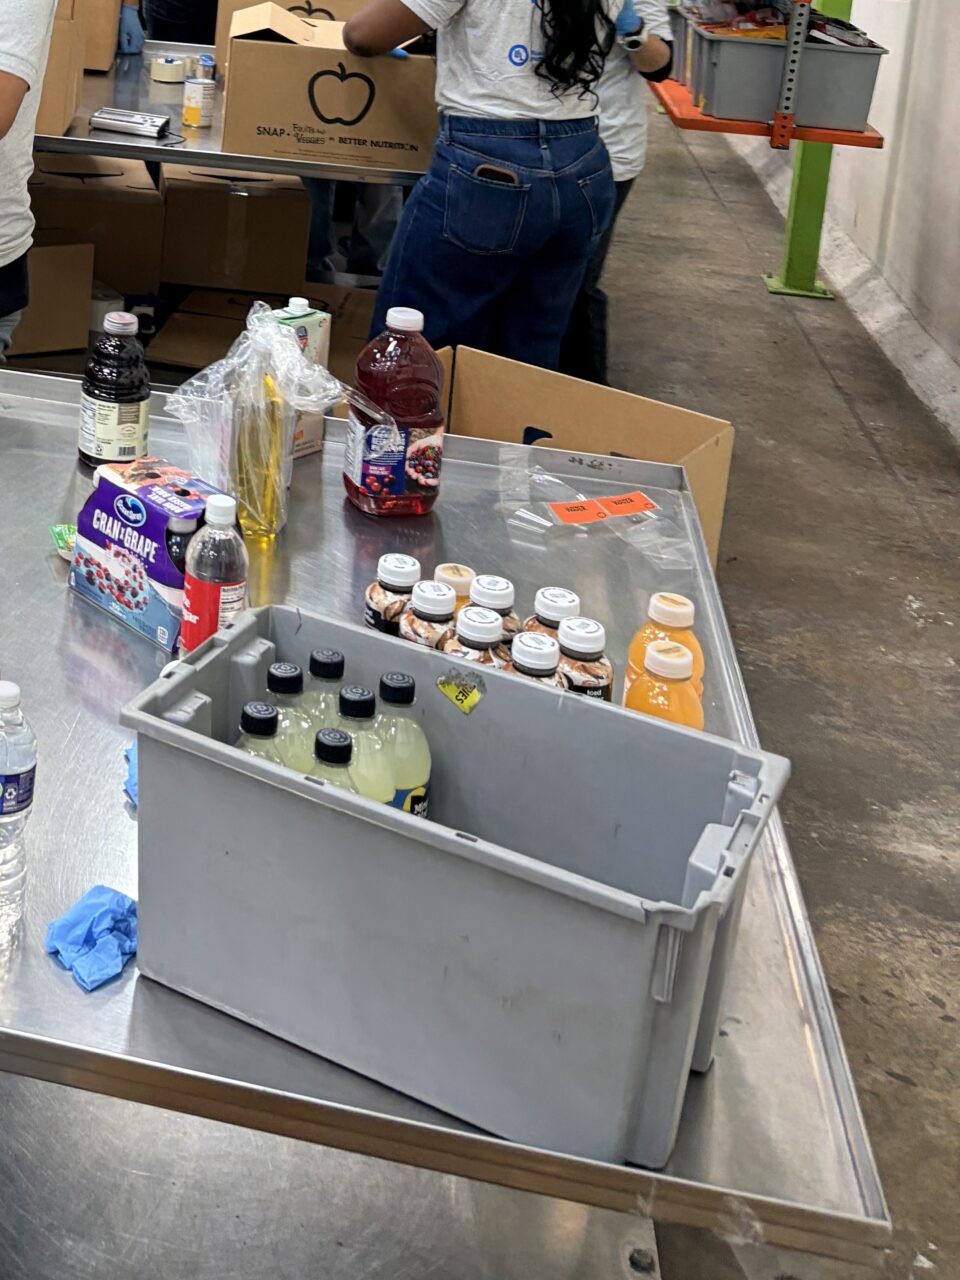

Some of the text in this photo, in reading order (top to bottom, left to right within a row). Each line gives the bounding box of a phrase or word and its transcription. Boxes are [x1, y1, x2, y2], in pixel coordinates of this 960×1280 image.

[256, 125, 285, 138] SNAP
[338, 136, 368, 146] BETTER
[370, 139, 419, 152] NUTRITION
